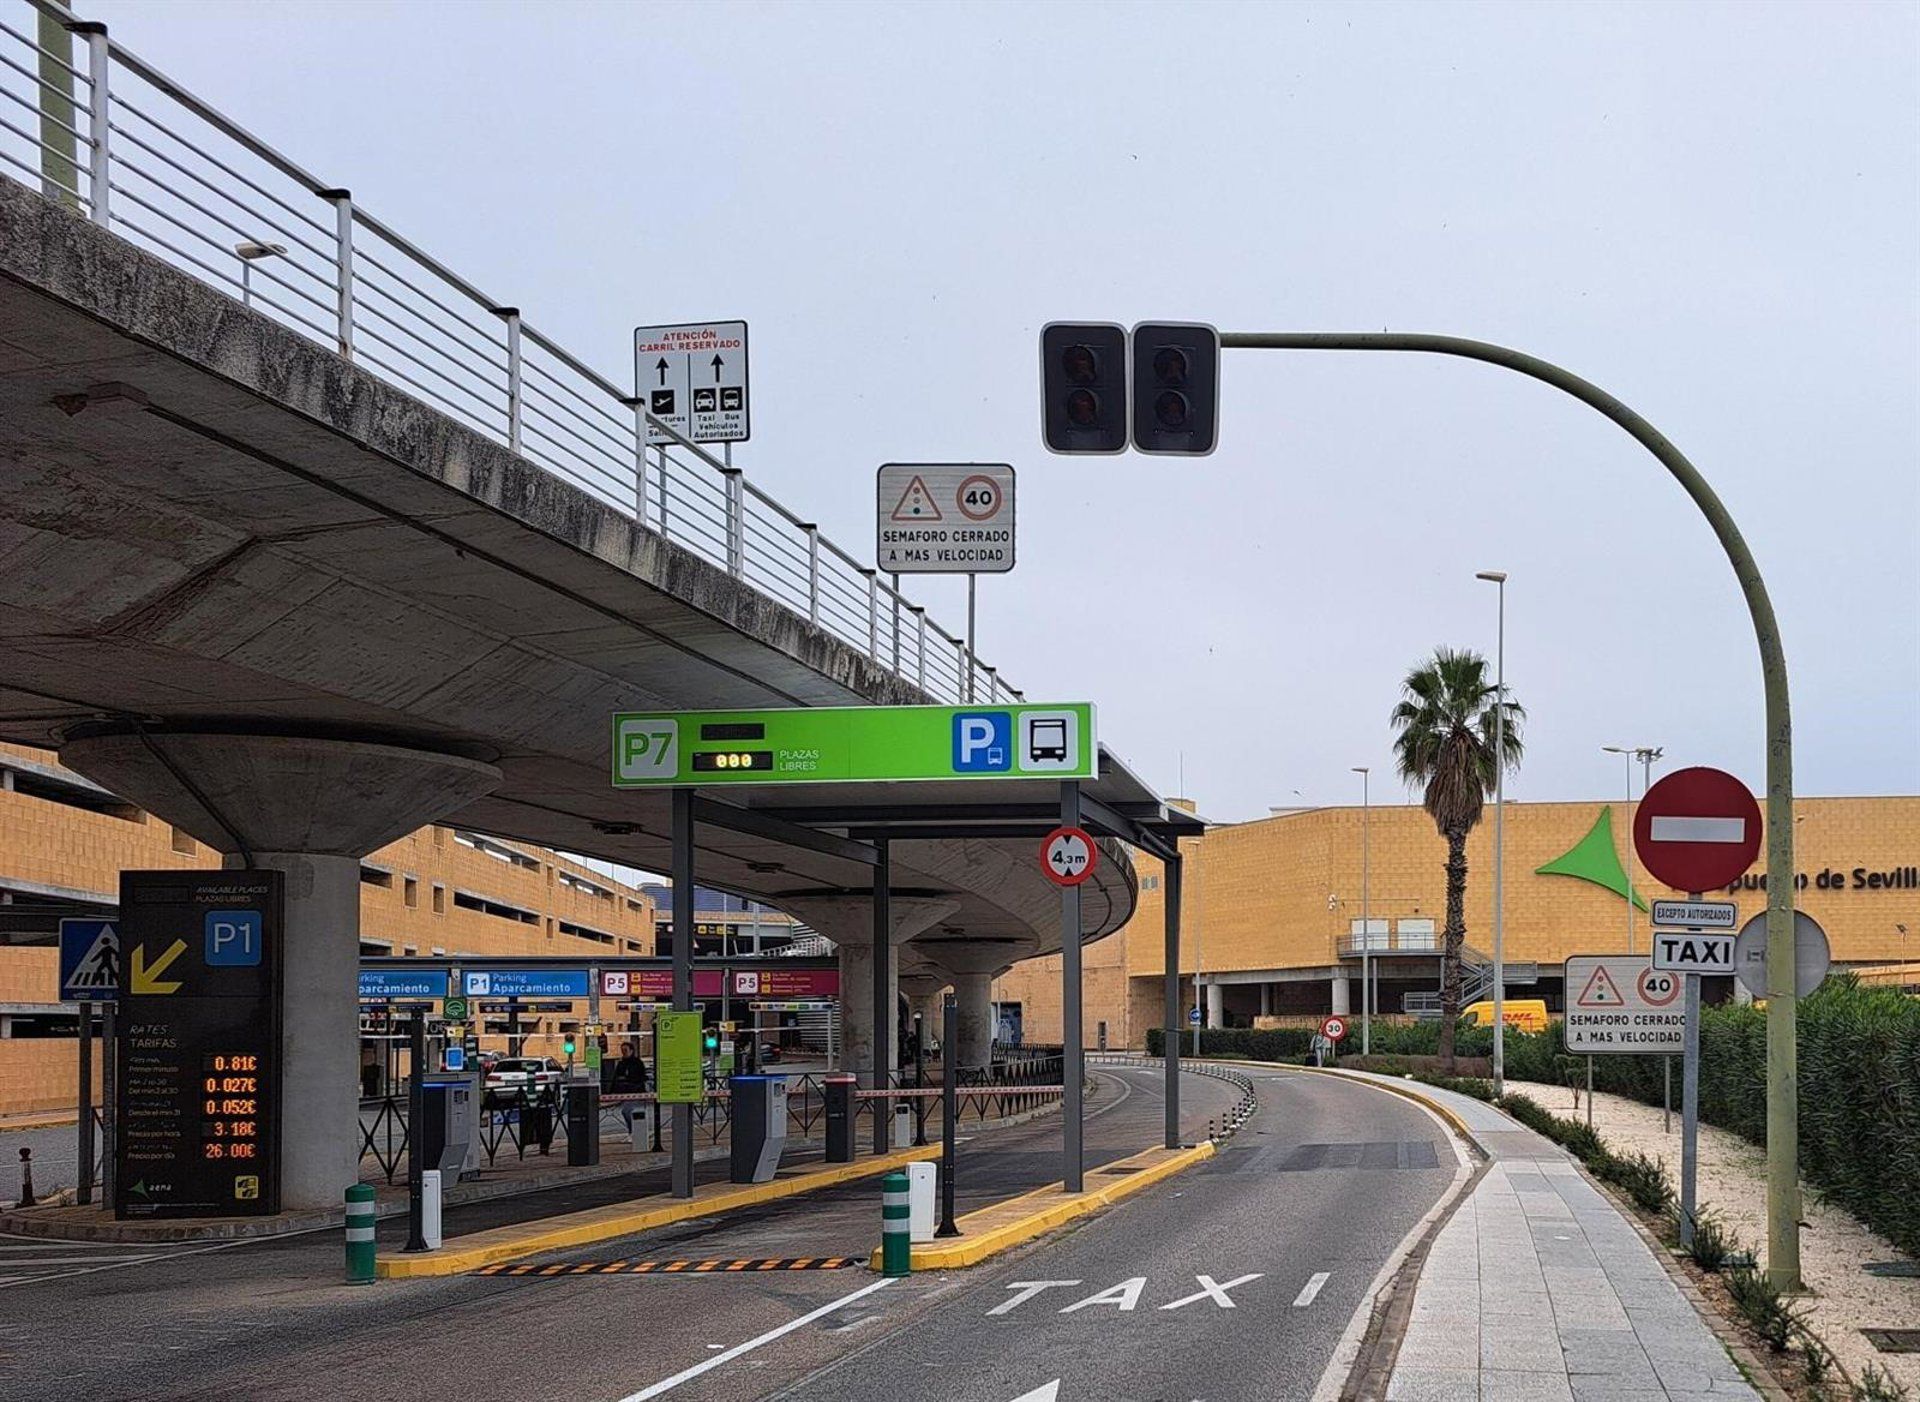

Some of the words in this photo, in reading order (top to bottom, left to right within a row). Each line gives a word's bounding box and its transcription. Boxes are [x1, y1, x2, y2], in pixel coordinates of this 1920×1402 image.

[663, 329, 717, 341] ATENCIÓN
[639, 343, 675, 352] CARRIL
[678, 340, 741, 350] RESERVADO
[699, 422, 738, 430] Vehículos
[694, 430, 744, 438] Autorizados
[965, 491, 992, 505] 40
[883, 531, 947, 543] SEMAFORO
[952, 530, 1009, 542] CERRADO
[889, 550, 897, 561] A
[905, 550, 929, 561] MAS
[937, 549, 1003, 561] VELOCIDAD
[960, 718, 995, 763] P
[624, 731, 673, 766] P7
[780, 749, 820, 759] PLAZAS
[780, 760, 817, 771] LIBRES
[1816, 868, 1845, 889] de
[1852, 866, 1920, 889] Sevill
[1657, 907, 1686, 918] EXCEPTO
[1687, 908, 1732, 921] AUTORIZADOS
[213, 923, 251, 953] P1
[1661, 940, 1730, 964] TAXI
[469, 977, 488, 990] P1
[493, 973, 527, 983] Parking
[606, 977, 626, 989] P5
[738, 977, 756, 989] P5
[359, 984, 430, 994] parcamiento
[493, 983, 571, 993] Aparcamiento
[1645, 978, 1671, 993] 40
[1570, 1015, 1629, 1026] SEMAFORO
[130, 1024, 169, 1035] RATES
[1328, 1023, 1340, 1032] 30
[130, 1038, 177, 1048] TARIFAS
[1576, 1032, 1583, 1042] A
[1589, 1032, 1613, 1042] MAS
[1620, 1032, 1682, 1043] VELOCIDAD
[215, 1056, 257, 1071] 0.81€
[206, 1078, 257, 1093] 0.027€
[206, 1100, 257, 1115] 0.052€
[214, 1122, 257, 1136] 3.18€
[206, 1143, 255, 1158] 26.00€
[149, 1184, 172, 1192] aena
[985, 1271, 1331, 1316] TAXI
